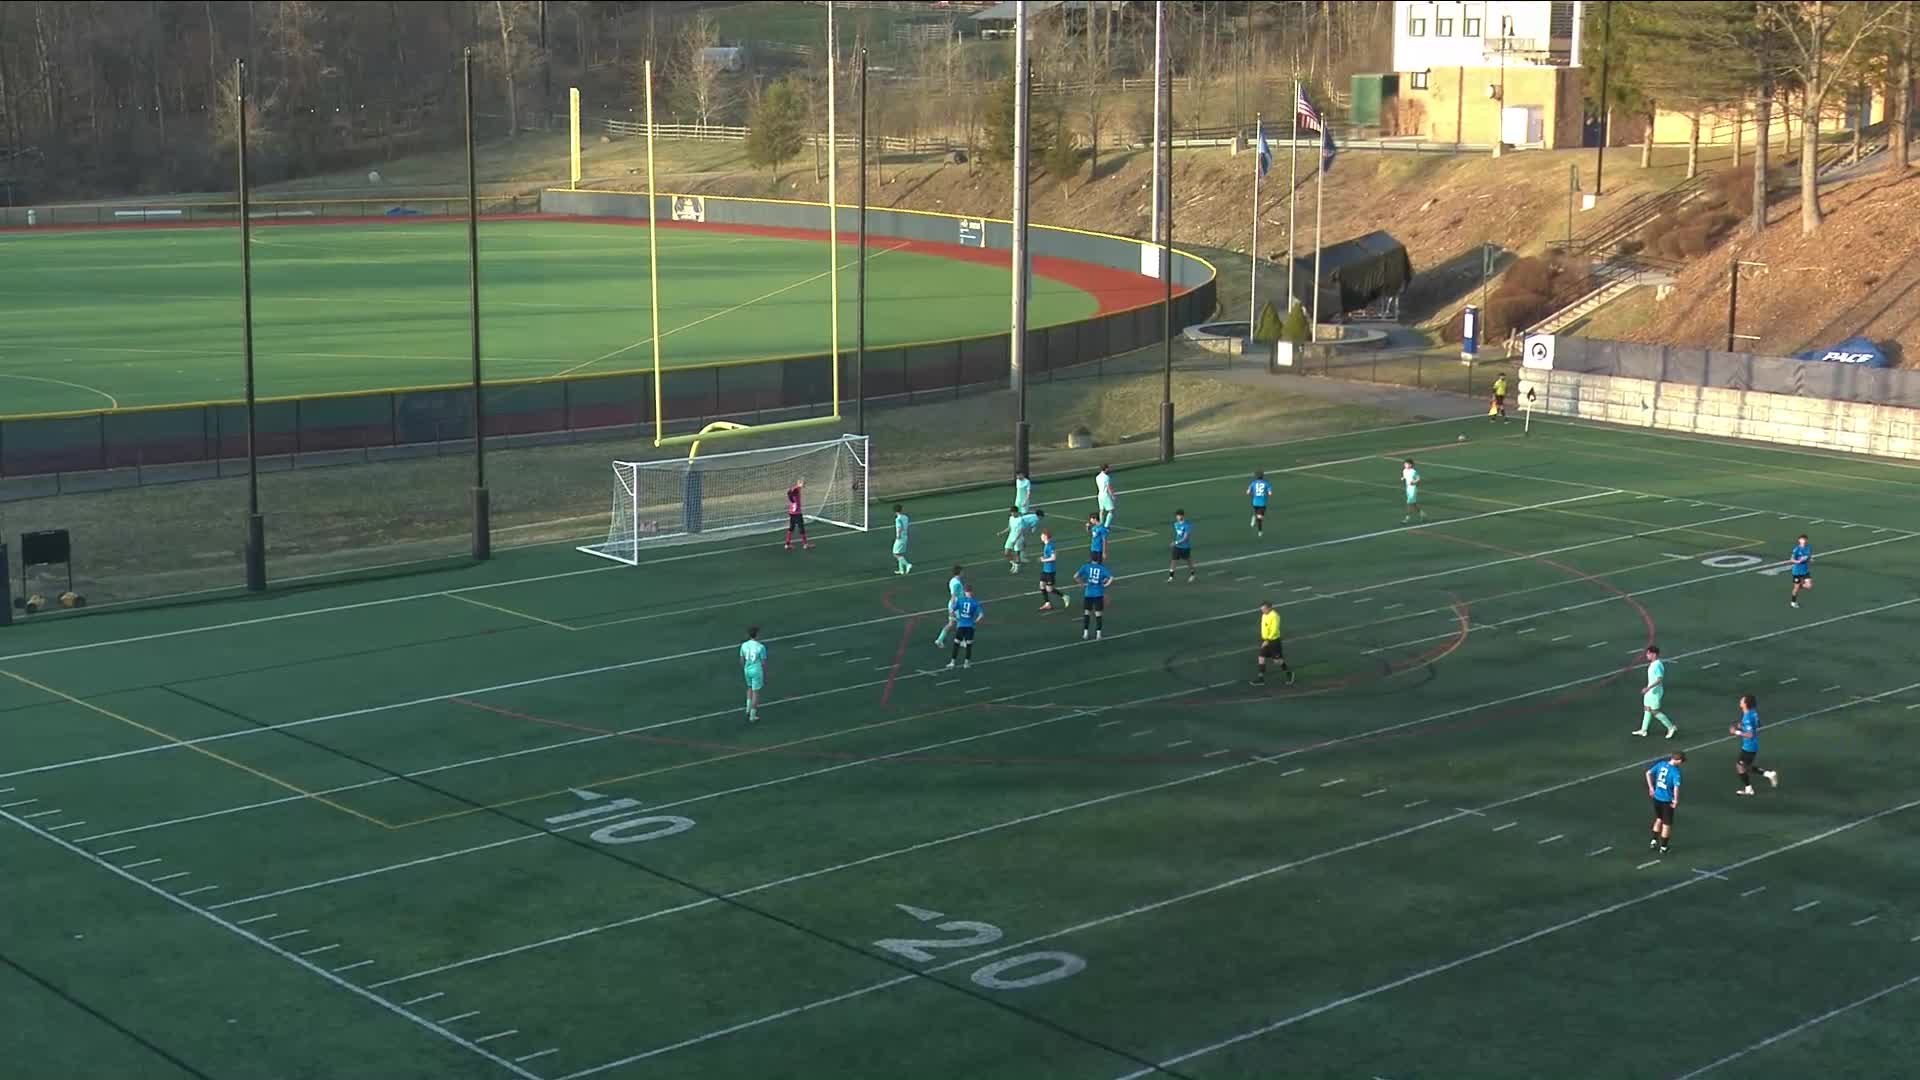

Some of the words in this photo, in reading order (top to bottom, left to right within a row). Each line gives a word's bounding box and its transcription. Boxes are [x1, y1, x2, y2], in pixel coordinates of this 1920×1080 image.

[1255, 482, 1265, 493] 12
[1090, 567, 1100, 579] 19
[963, 602, 971, 613] 9
[1658, 767, 1668, 782] 2
[544, 798, 697, 844] 10
[872, 920, 1087, 989] 20
